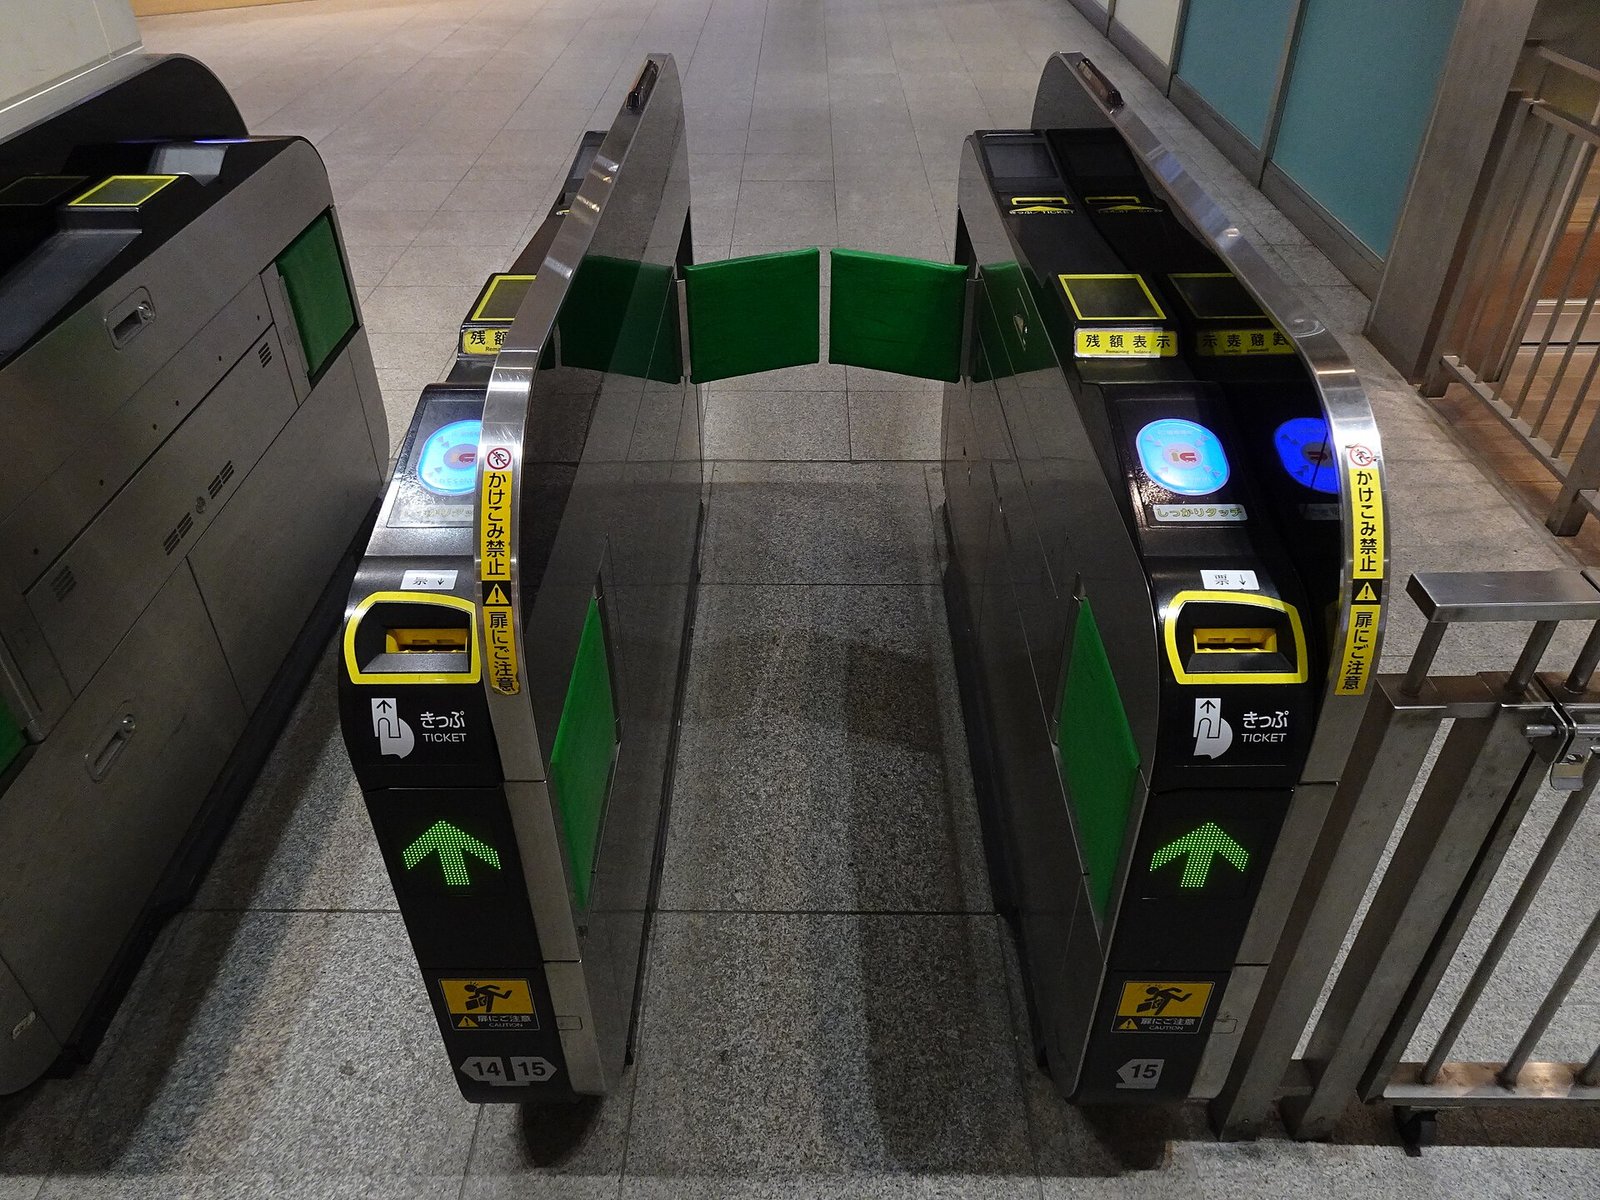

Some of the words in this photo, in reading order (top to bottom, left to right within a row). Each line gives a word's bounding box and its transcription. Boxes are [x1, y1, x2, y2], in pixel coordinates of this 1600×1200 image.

[1086, 334, 1170, 348] 残額表示
[1157, 507, 1242, 518] しっかりタッチ
[486, 472, 506, 576] かけこみ禁止
[1356, 470, 1377, 572] かけこみ禁止
[488, 611, 515, 692] 扉にご注意
[1342, 611, 1373, 690] 扉にご注意
[420, 711, 466, 728] きっぷ
[1242, 711, 1289, 728] きっぷ
[422, 733, 467, 743] TICKET
[1241, 733, 1287, 743] TICKET
[472, 1062, 501, 1076] 14
[518, 1062, 546, 1076] 15
[1131, 1064, 1159, 1079] 15
